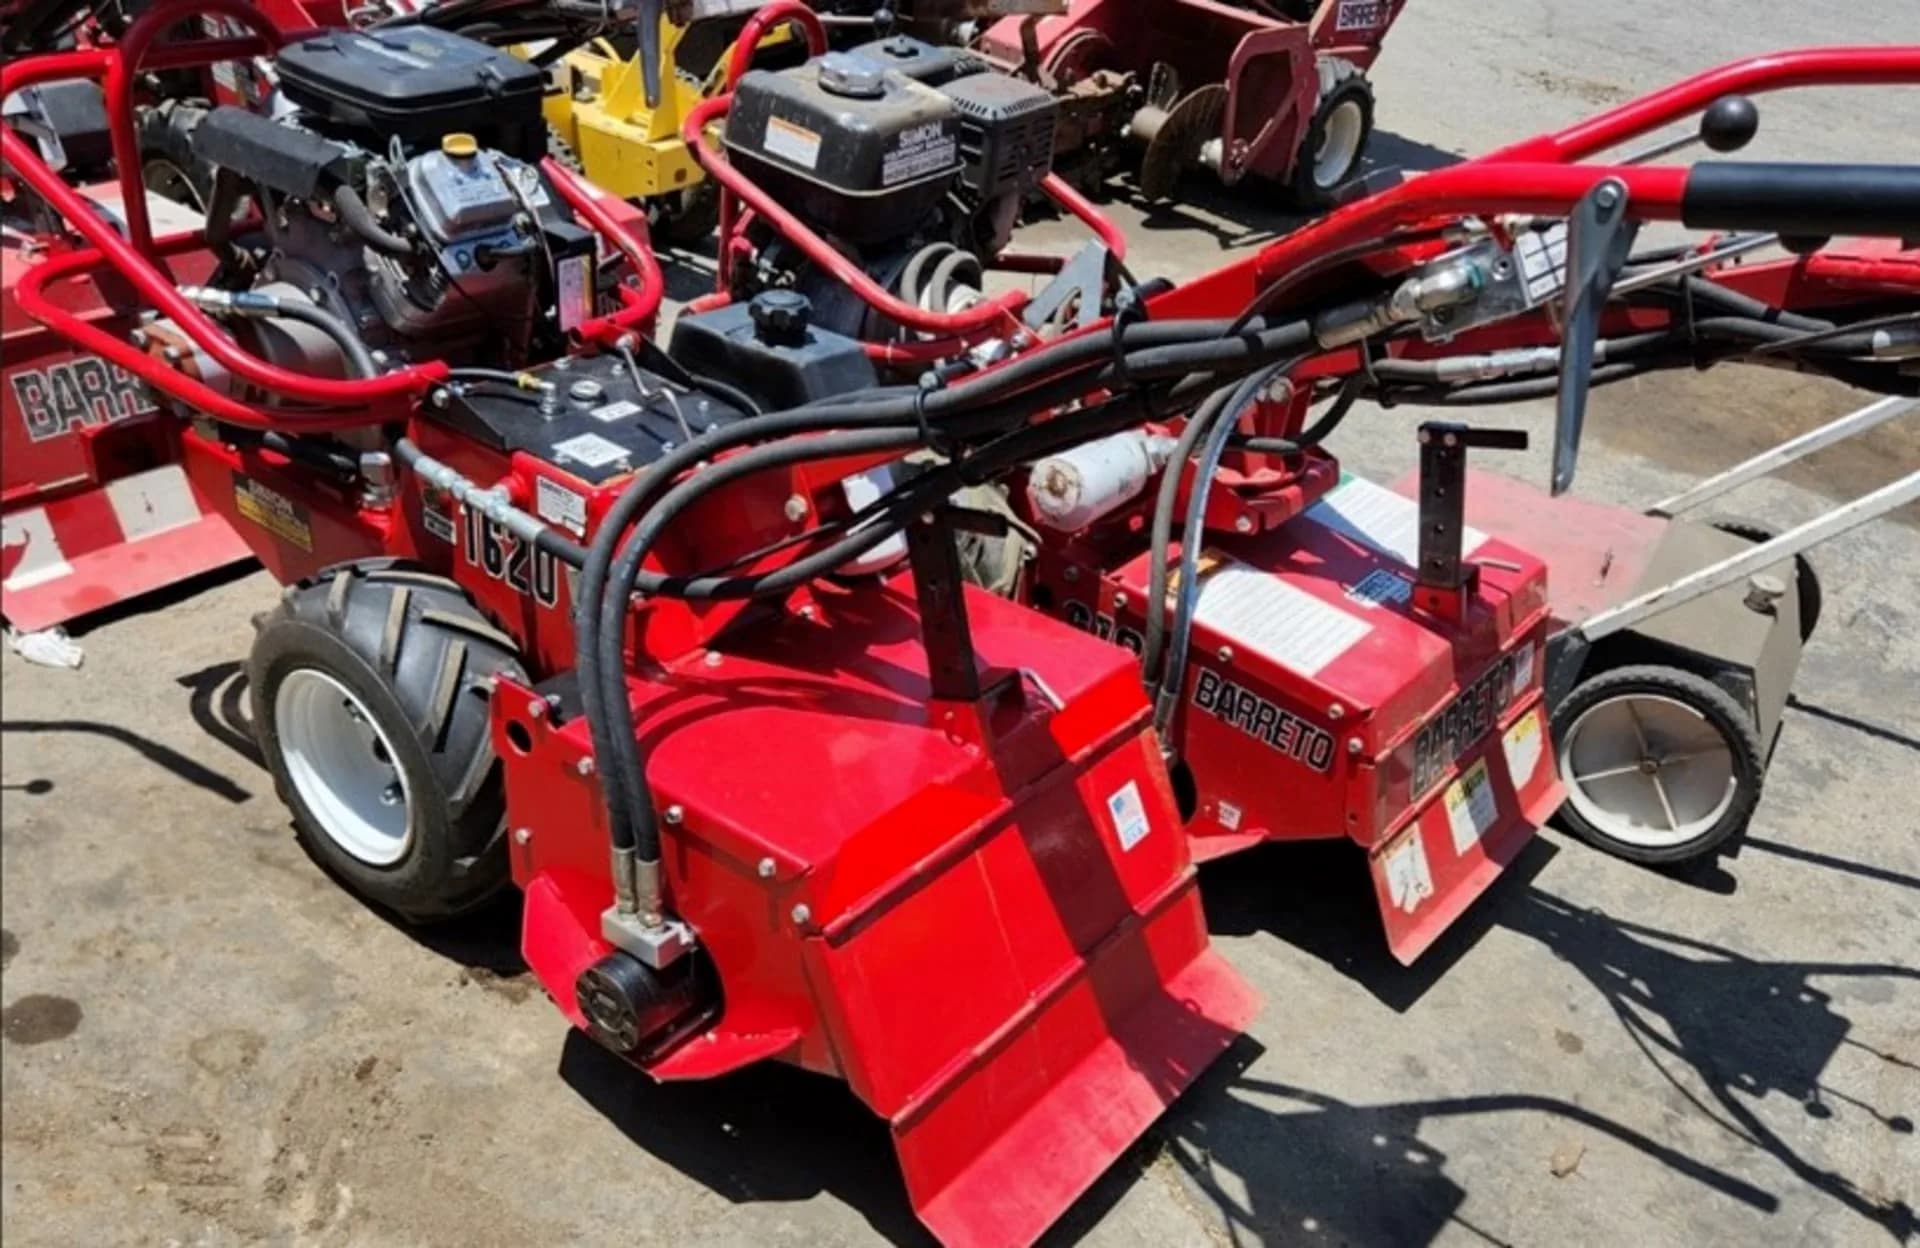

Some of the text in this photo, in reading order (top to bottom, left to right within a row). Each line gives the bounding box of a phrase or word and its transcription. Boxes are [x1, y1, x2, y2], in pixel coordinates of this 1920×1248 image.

[10, 355, 160, 442] BARR
[459, 501, 558, 609] 1620
[1191, 666, 1336, 774] BARRETO
